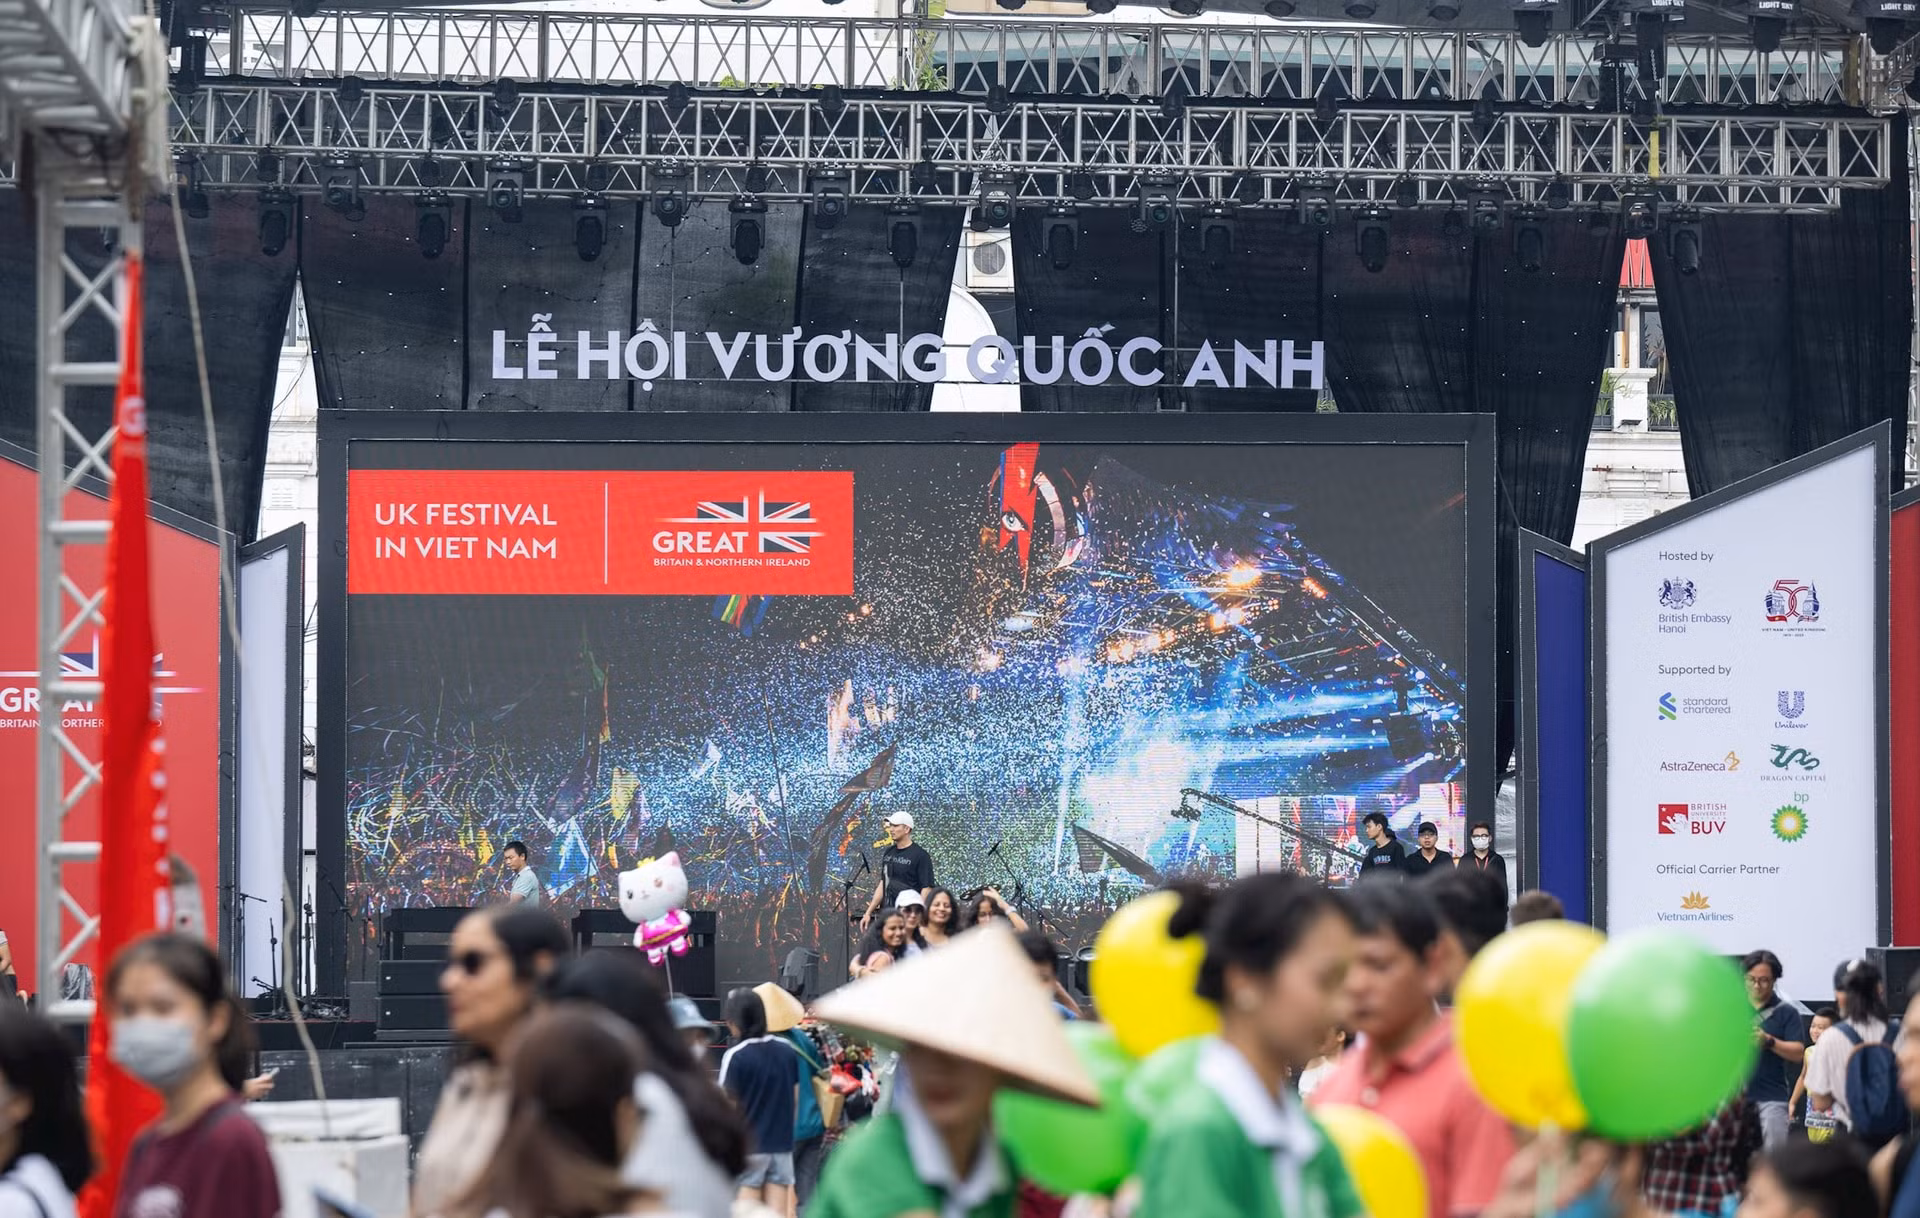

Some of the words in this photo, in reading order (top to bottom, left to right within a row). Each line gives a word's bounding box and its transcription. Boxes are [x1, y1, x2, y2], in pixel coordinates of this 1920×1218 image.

[1759, 1, 1780, 9] LIGHT
[1781, 2, 1793, 10] SKY
[1881, 3, 1901, 11] LIGHT
[492, 313, 558, 380] LỄ
[577, 318, 687, 392] HỘI
[705, 325, 947, 383] VƯƠNG
[966, 321, 1165, 386] QUỐC
[1182, 338, 1325, 390] ANH
[375, 503, 418, 526] UK
[426, 503, 557, 526] FESTIVAL
[375, 537, 406, 559] IN
[414, 537, 479, 559] VIET
[487, 537, 557, 559] NAM
[652, 531, 749, 554] GREAT
[1659, 551, 1698, 561] Hosted
[1700, 551, 1714, 562] by
[653, 558, 694, 567] BRITAIN
[695, 558, 704, 567] &
[706, 558, 763, 567] NORTHERN
[765, 558, 811, 567] IRELAND
[1658, 613, 1689, 623] British
[1691, 613, 1732, 624] Embassy
[1658, 624, 1686, 633] Hanoi
[1658, 665, 1715, 676] Supported
[1718, 665, 1732, 676] by
[1683, 697, 1728, 706] standard
[1683, 705, 1731, 714] chartered
[1660, 761, 1726, 772] AstraZeneca
[1794, 791, 1810, 804] bp
[1690, 803, 1727, 811] BRITISH
[1691, 821, 1726, 834] BUV
[1656, 864, 1696, 874] Official
[1699, 864, 1737, 874] Carrier
[1740, 864, 1780, 874] Partner
